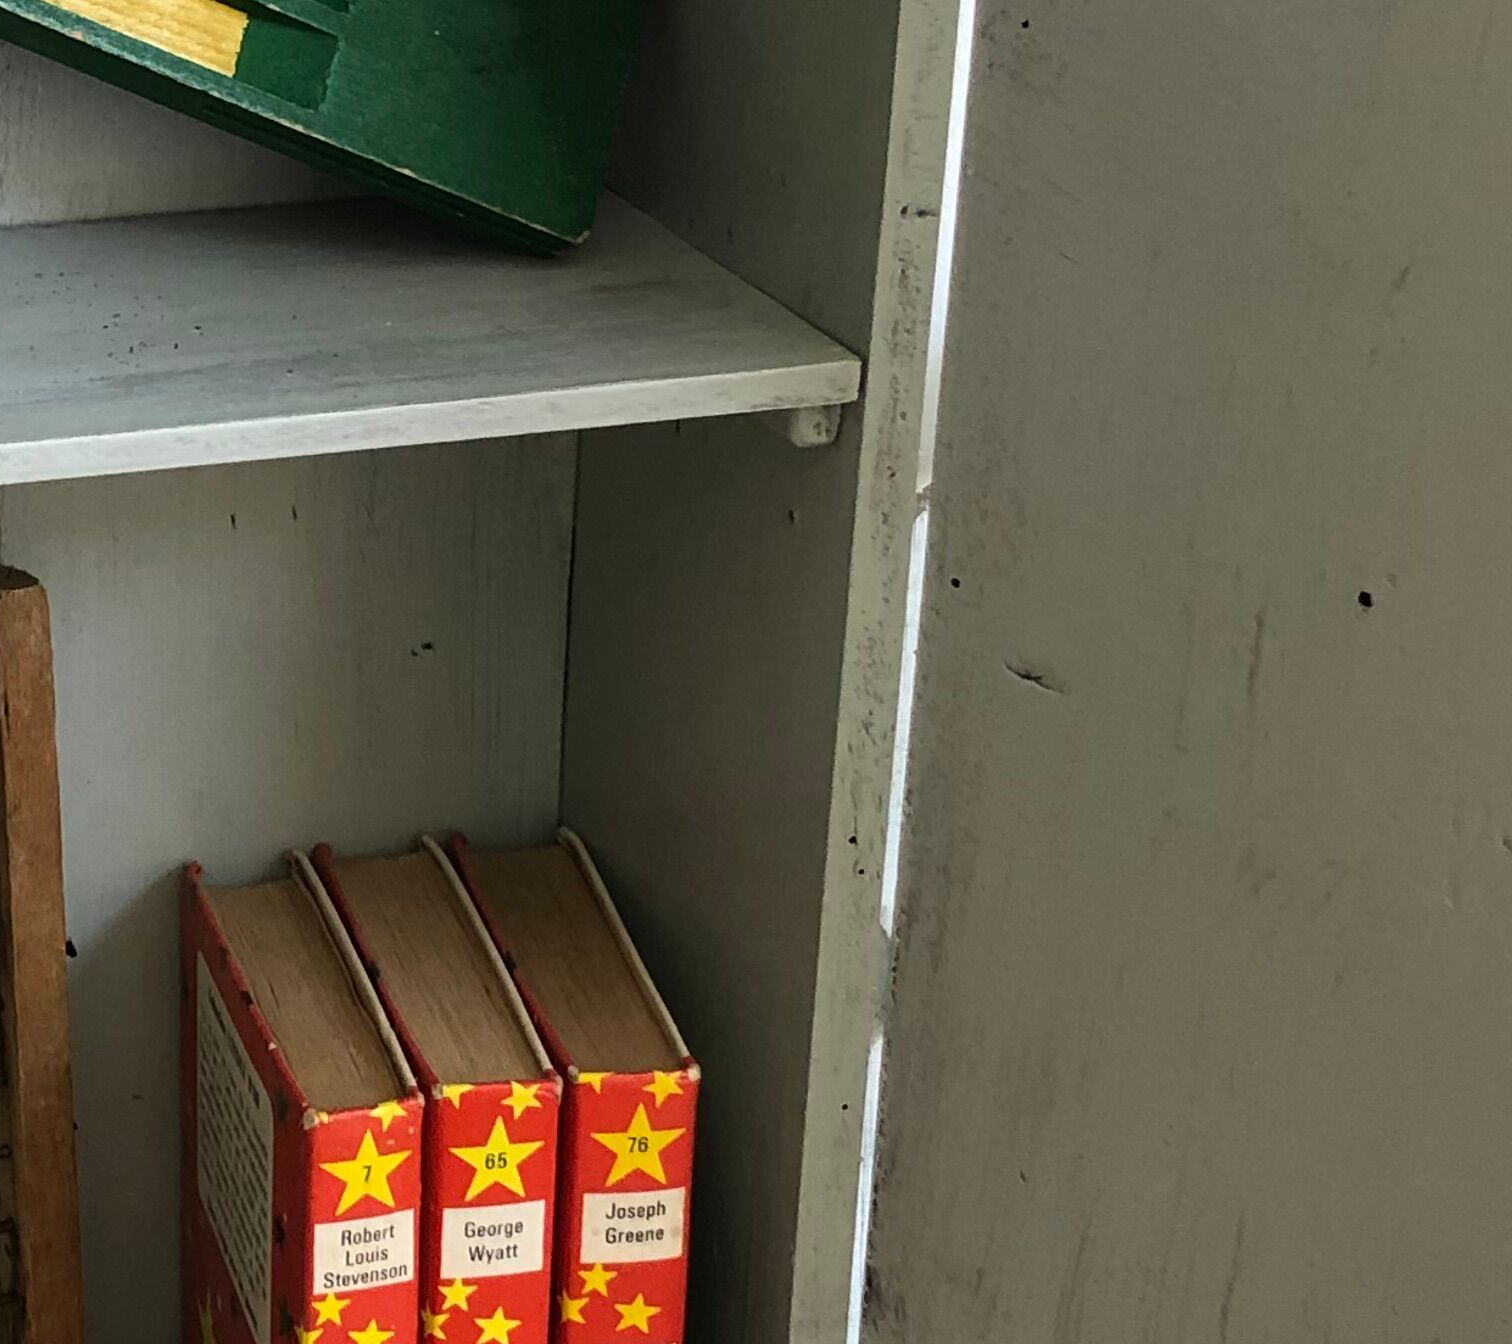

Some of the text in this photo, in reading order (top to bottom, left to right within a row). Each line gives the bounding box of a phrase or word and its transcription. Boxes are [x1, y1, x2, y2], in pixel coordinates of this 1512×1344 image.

[627, 1136, 649, 1153] 76
[484, 1152, 508, 1170] 65
[363, 1165, 372, 1183] 7
[605, 1199, 666, 1222] Joseph
[340, 1224, 395, 1246] Robert
[464, 1218, 524, 1239] George
[605, 1226, 664, 1245] Greene
[345, 1247, 389, 1266] Louis
[469, 1244, 518, 1264] Wyatt
[323, 1263, 408, 1289] Stevenson
